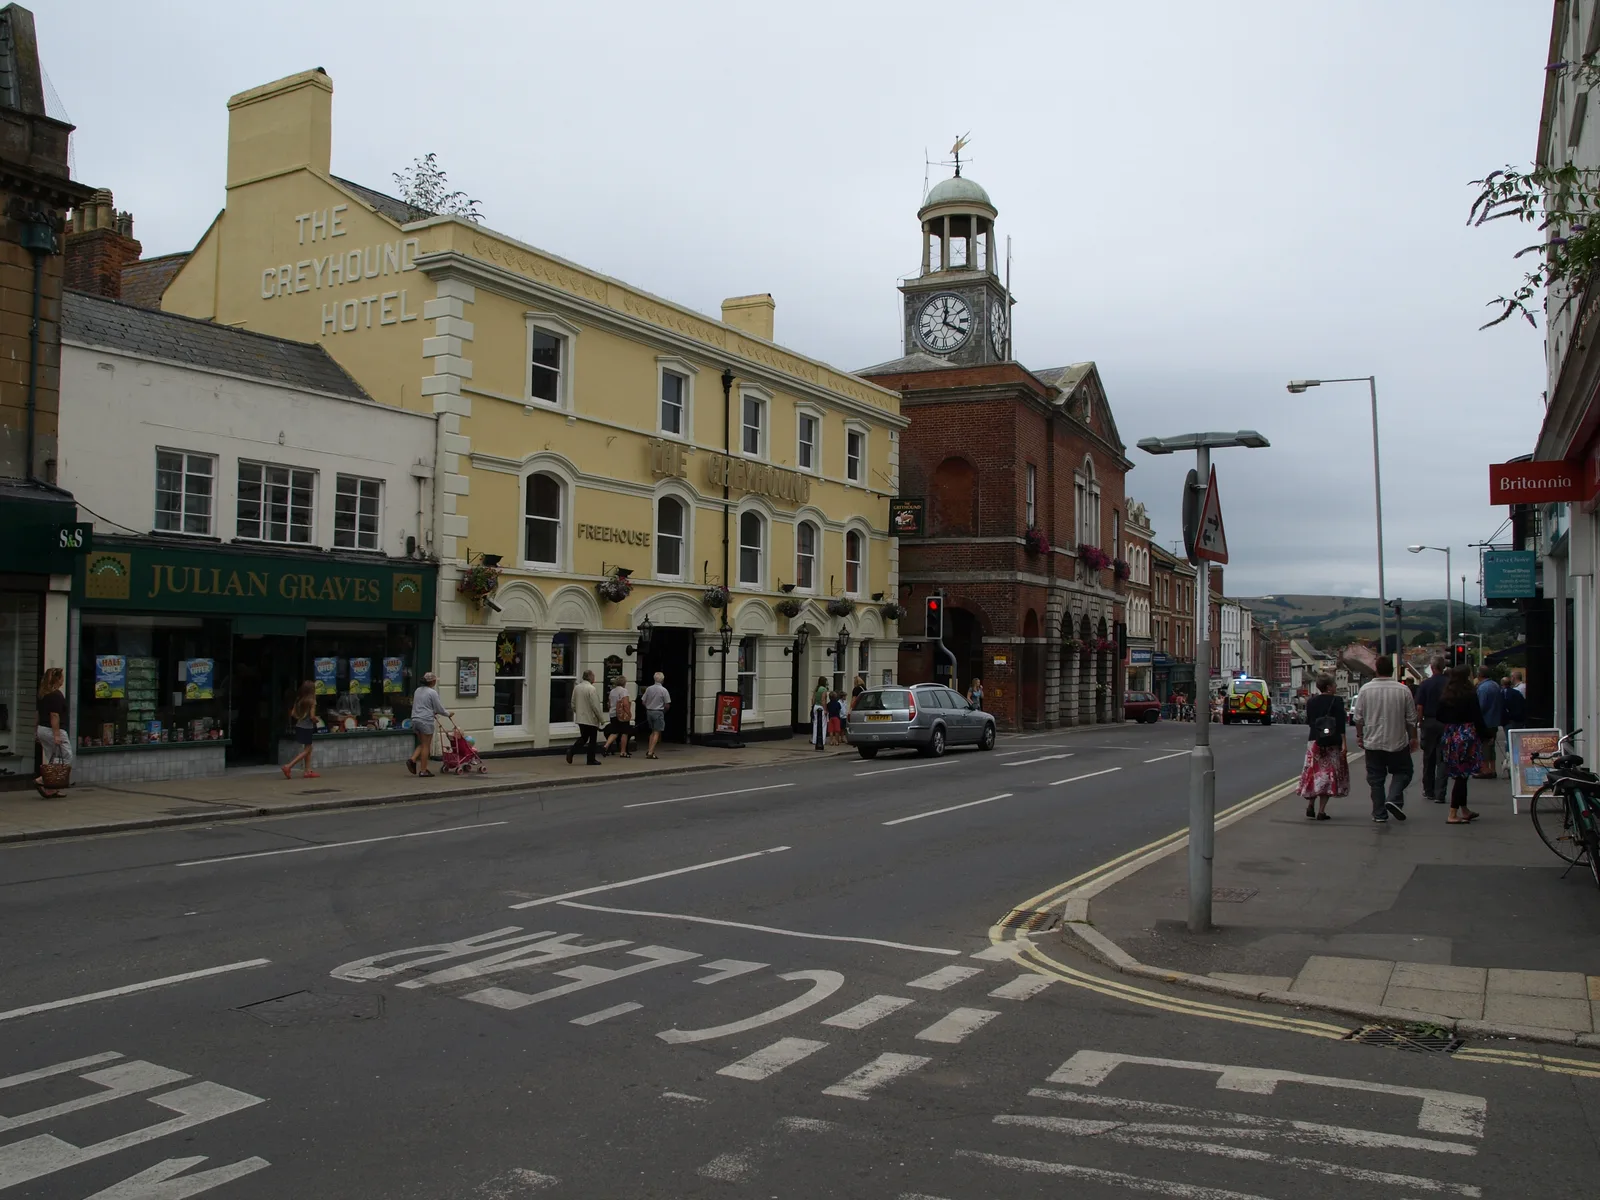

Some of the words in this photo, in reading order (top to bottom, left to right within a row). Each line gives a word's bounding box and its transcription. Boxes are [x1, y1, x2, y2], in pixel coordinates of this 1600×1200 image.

[295, 204, 348, 245] THE
[261, 237, 421, 300] GREYHOUND
[321, 289, 418, 335] HOTEL
[648, 438, 688, 479] THE
[708, 452, 812, 504] GREYHOUND
[1500, 475, 1572, 491] Britannia
[59, 528, 83, 548] S&S
[577, 523, 651, 547] FREEHOUSE
[149, 564, 269, 599] JULIAN
[279, 572, 380, 603] GRAVES
[102, 659, 121, 667] HALF
